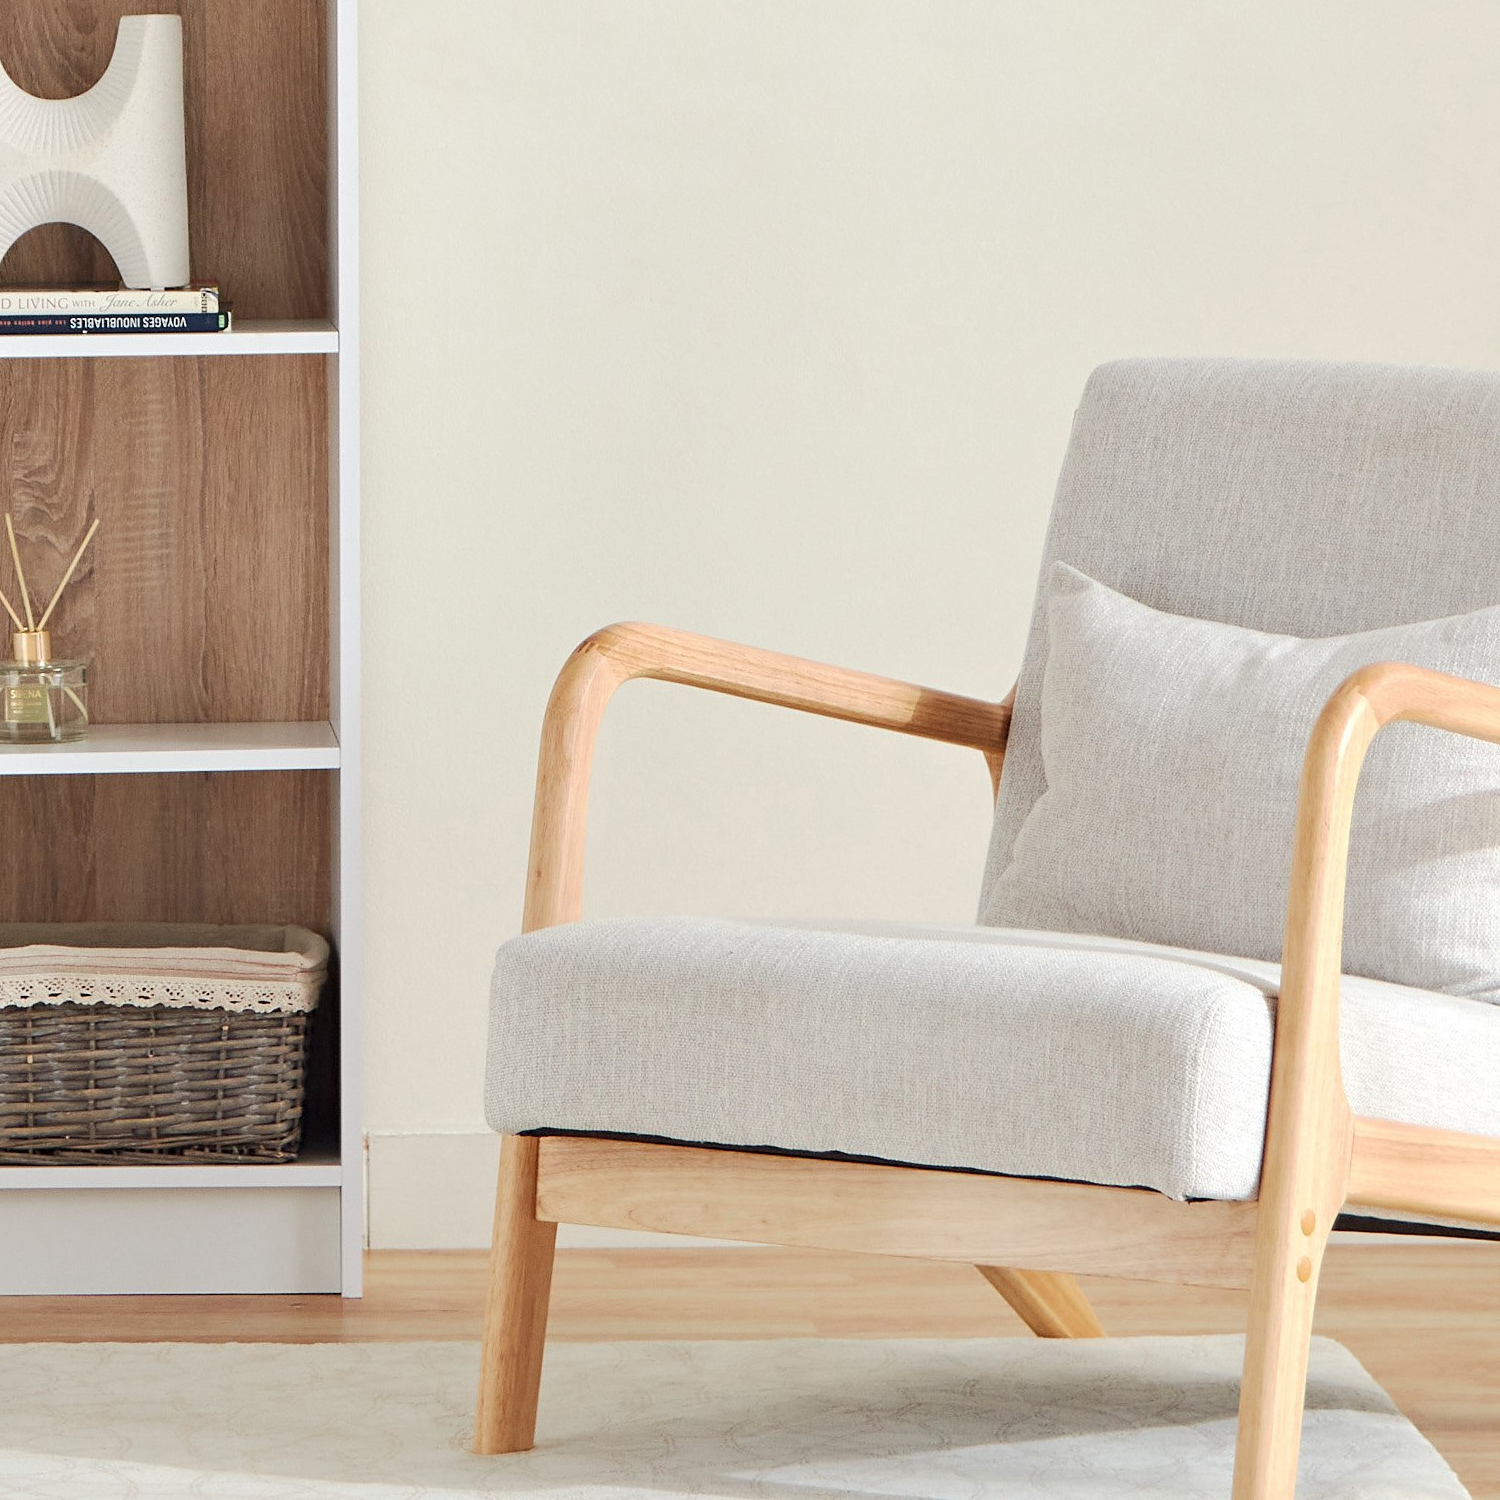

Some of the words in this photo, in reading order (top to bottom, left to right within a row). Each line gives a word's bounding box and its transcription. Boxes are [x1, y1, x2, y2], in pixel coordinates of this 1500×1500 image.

[18, 298, 68, 310] LIVING
[72, 300, 95, 308] WITH
[100, 294, 135, 312] Jane
[137, 294, 177, 308] Asher
[70, 317, 140, 329] INOUBLIABLES
[143, 316, 187, 328] VOYAGES
